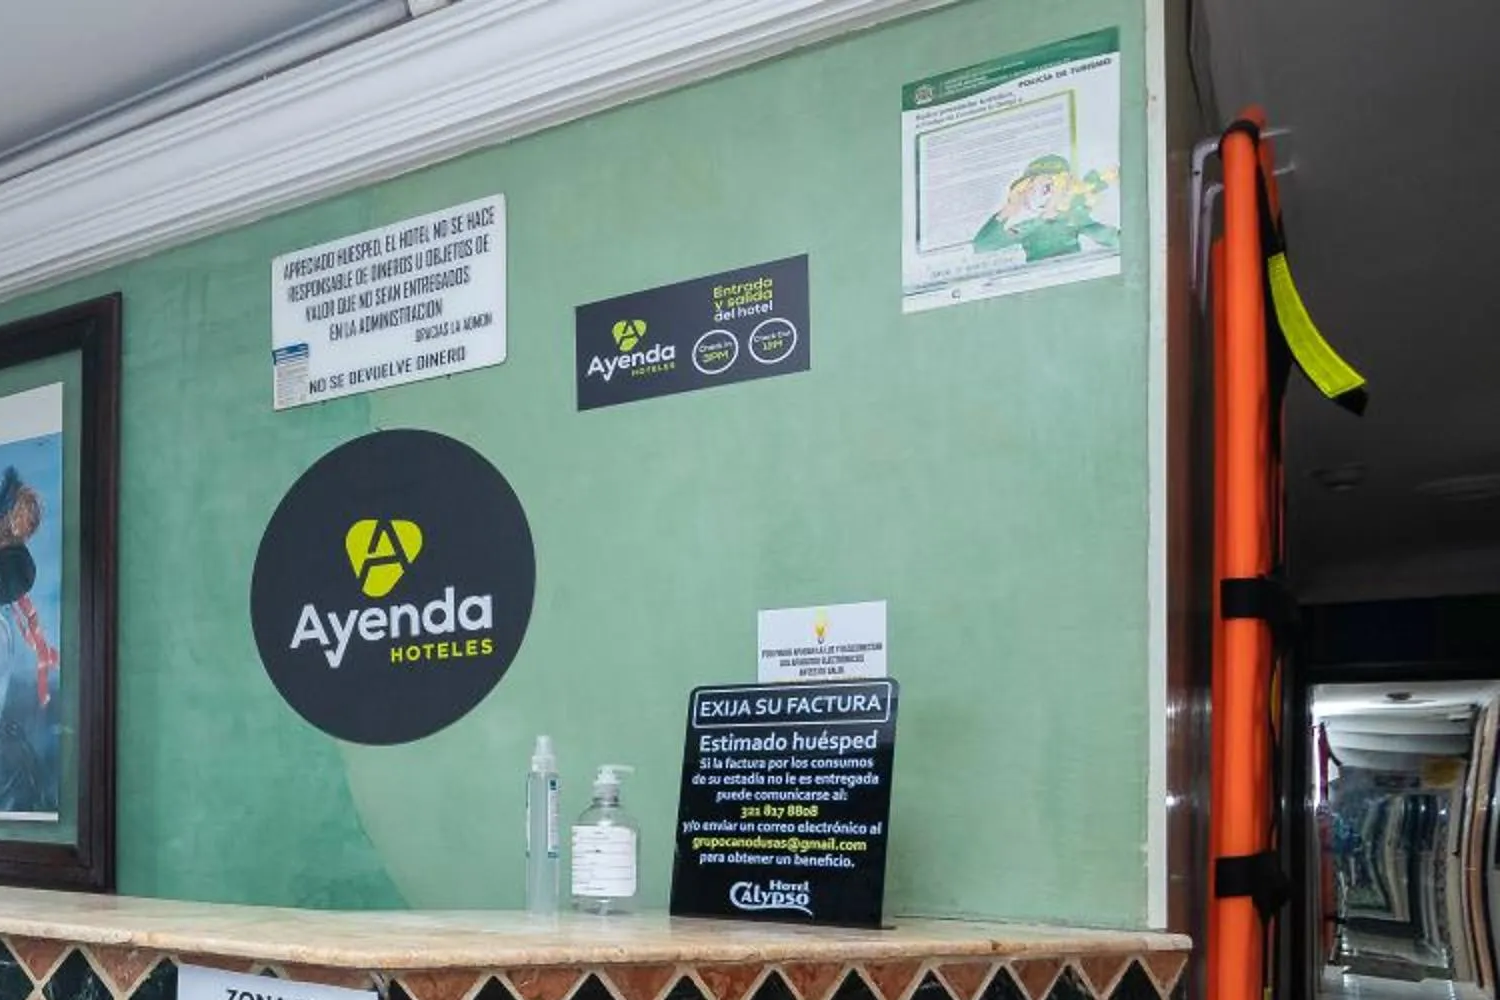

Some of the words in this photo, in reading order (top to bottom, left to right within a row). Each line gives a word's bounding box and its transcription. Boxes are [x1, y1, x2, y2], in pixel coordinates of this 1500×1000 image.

[283, 252, 335, 281] APRECIADO
[385, 233, 397, 254] EL
[399, 225, 430, 250] HOTEL
[433, 219, 449, 241] NO
[451, 215, 465, 236] SE
[467, 205, 495, 231] HACE
[288, 269, 353, 303] RESPONSABLE
[355, 267, 368, 286] DE
[371, 255, 413, 283] DINEROS
[415, 251, 423, 271] U
[425, 239, 474, 267] OBJETOS
[475, 233, 489, 256] DE
[305, 299, 336, 323] VALOR
[337, 294, 357, 316] QUE
[359, 289, 373, 309] NO
[375, 282, 401, 307] SEAN
[403, 265, 471, 299] ENTREGADOS
[713, 277, 773, 299] Entrada
[713, 299, 723, 312] y
[727, 289, 773, 309] salida
[713, 307, 736, 323] del
[737, 299, 773, 319] hotel
[329, 321, 343, 341] EN
[345, 319, 357, 339] LA
[359, 297, 443, 336] ADMINISTRACION
[450, 319, 461, 335] LA
[308, 378, 327, 395] NO
[329, 372, 345, 390] SE
[349, 356, 412, 386] DEVUELVE
[417, 345, 465, 372] DINERO
[587, 344, 676, 382] Ayenda
[631, 361, 676, 378] HOTELES
[289, 585, 493, 669] Ayenda
[390, 637, 494, 664] HOTELES
[700, 700, 752, 718] EXIJA
[755, 697, 782, 716] SU
[786, 694, 882, 715] FACTURA
[699, 732, 788, 753] Estimado
[791, 728, 879, 756] huésped
[699, 757, 712, 770] Si
[712, 756, 724, 769] la
[725, 757, 767, 770] factura
[767, 758, 789, 772] por
[791, 756, 809, 769] los
[811, 758, 875, 769] consumos
[691, 773, 707, 785] de
[708, 775, 722, 785] su
[723, 772, 766, 785] estadía
[767, 775, 784, 785] no
[785, 772, 798, 785] le
[799, 775, 814, 785] es
[815, 772, 880, 788] entregada
[716, 788, 753, 803] puede
[753, 788, 831, 801] comunicarse
[740, 806, 761, 819] 321
[763, 803, 785, 819] 817
[786, 803, 819, 817] 8808
[702, 819, 739, 833] enviar
[739, 822, 756, 833] un
[757, 821, 796, 834] correo
[797, 819, 868, 836] electrónico
[869, 821, 883, 836] al
[699, 854, 726, 867] para
[726, 852, 775, 865] obtener
[775, 854, 792, 866] un
[793, 852, 856, 869] beneficio.
